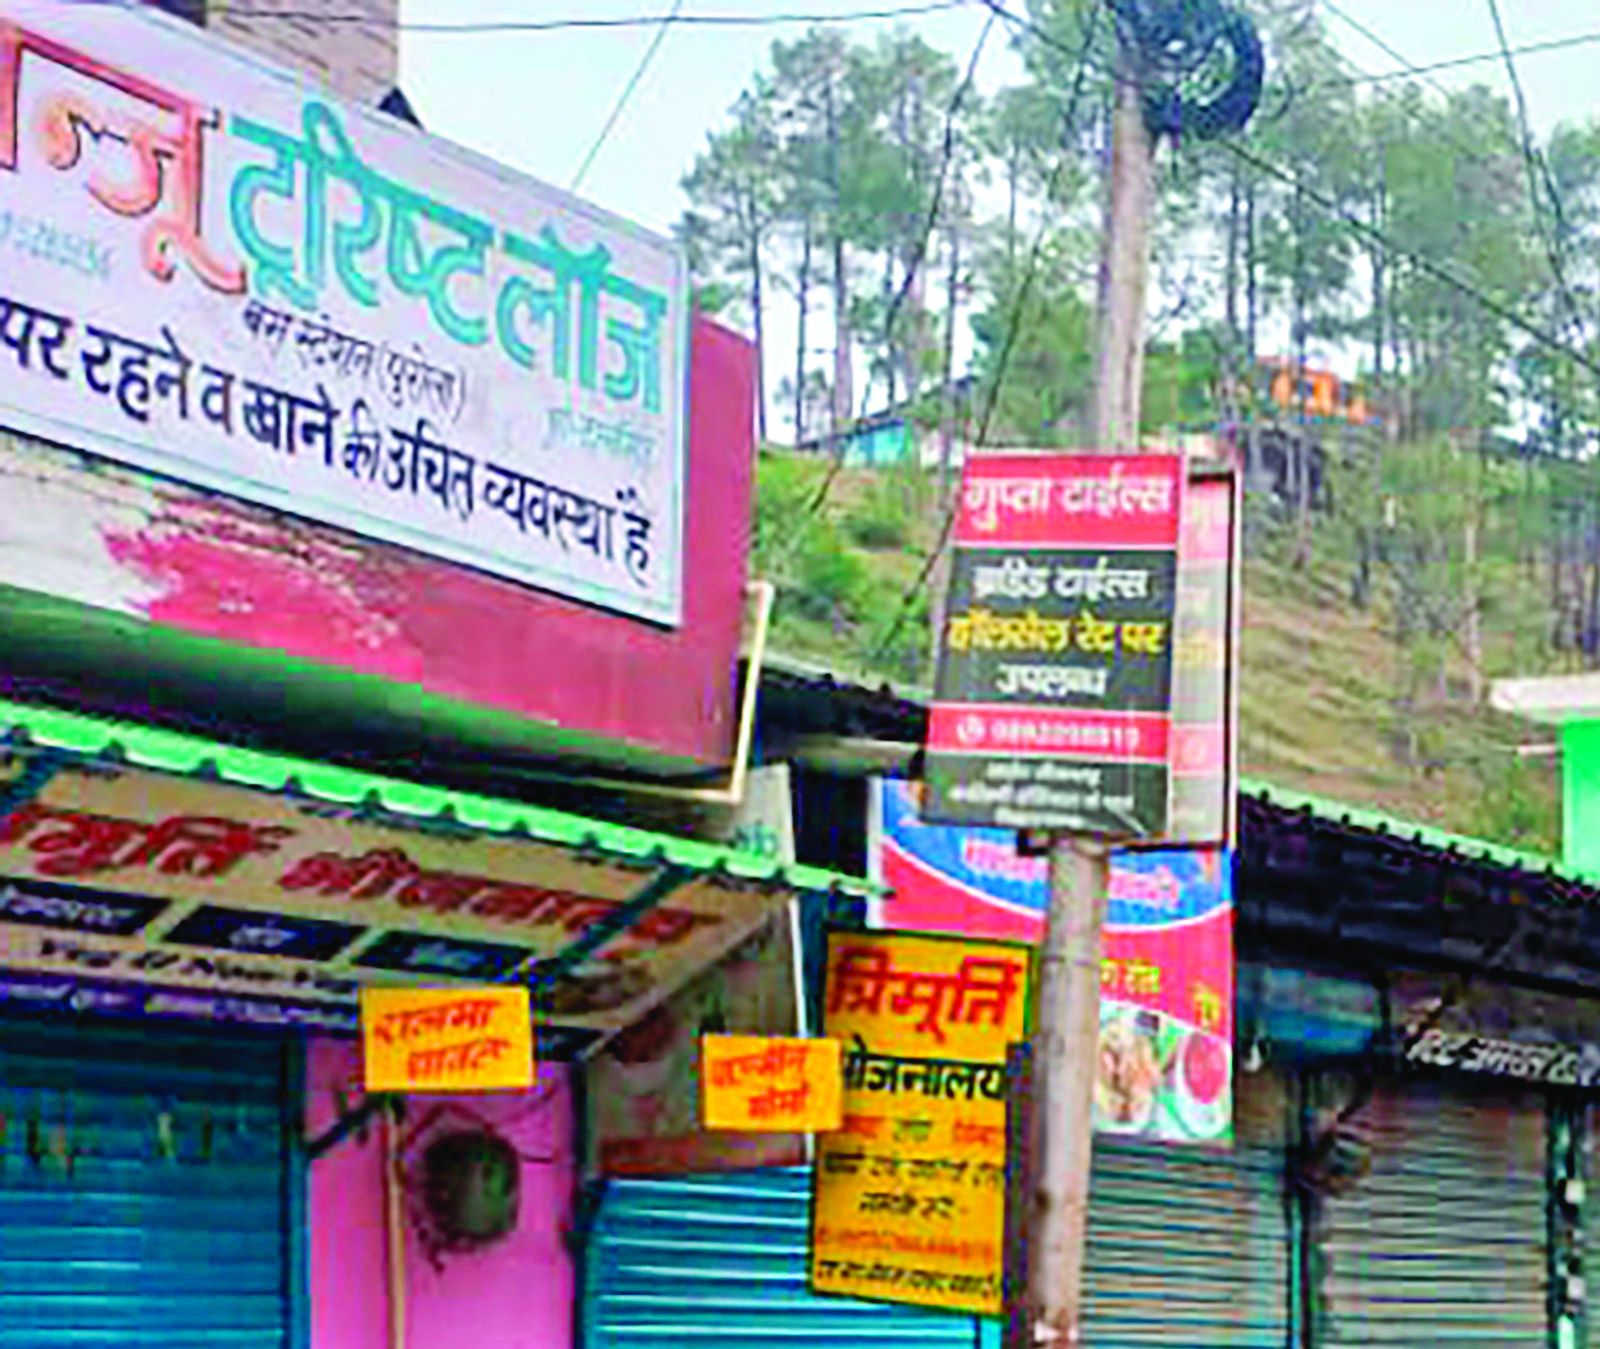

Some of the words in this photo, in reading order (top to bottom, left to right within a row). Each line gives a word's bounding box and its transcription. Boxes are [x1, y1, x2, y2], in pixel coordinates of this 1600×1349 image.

[82, 326, 192, 422] रहने
[200, 364, 236, 435] व
[242, 382, 340, 466] खाने
[344, 399, 381, 482] की
[964, 476, 1050, 531] गुप्ता
